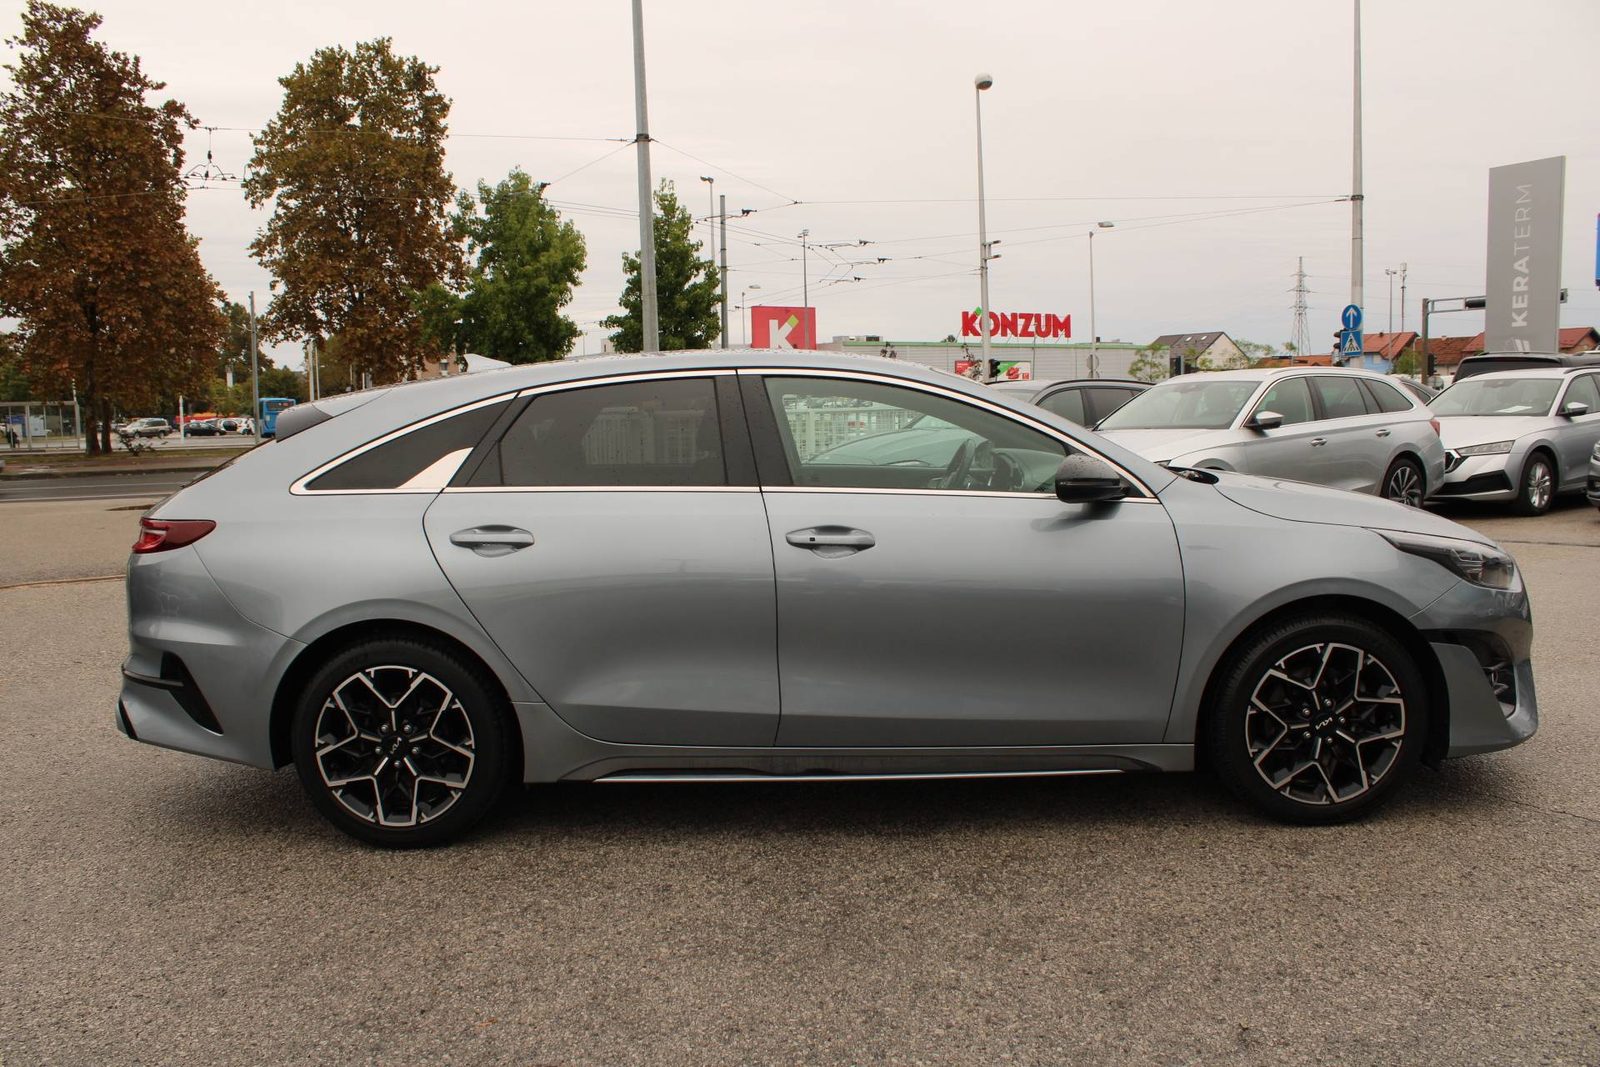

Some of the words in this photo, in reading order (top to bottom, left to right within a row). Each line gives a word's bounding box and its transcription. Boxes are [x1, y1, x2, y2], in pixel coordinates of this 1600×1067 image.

[1511, 183, 1533, 328] KERATERM
[768, 314, 799, 350] K
[961, 307, 1071, 338] KONZUM
